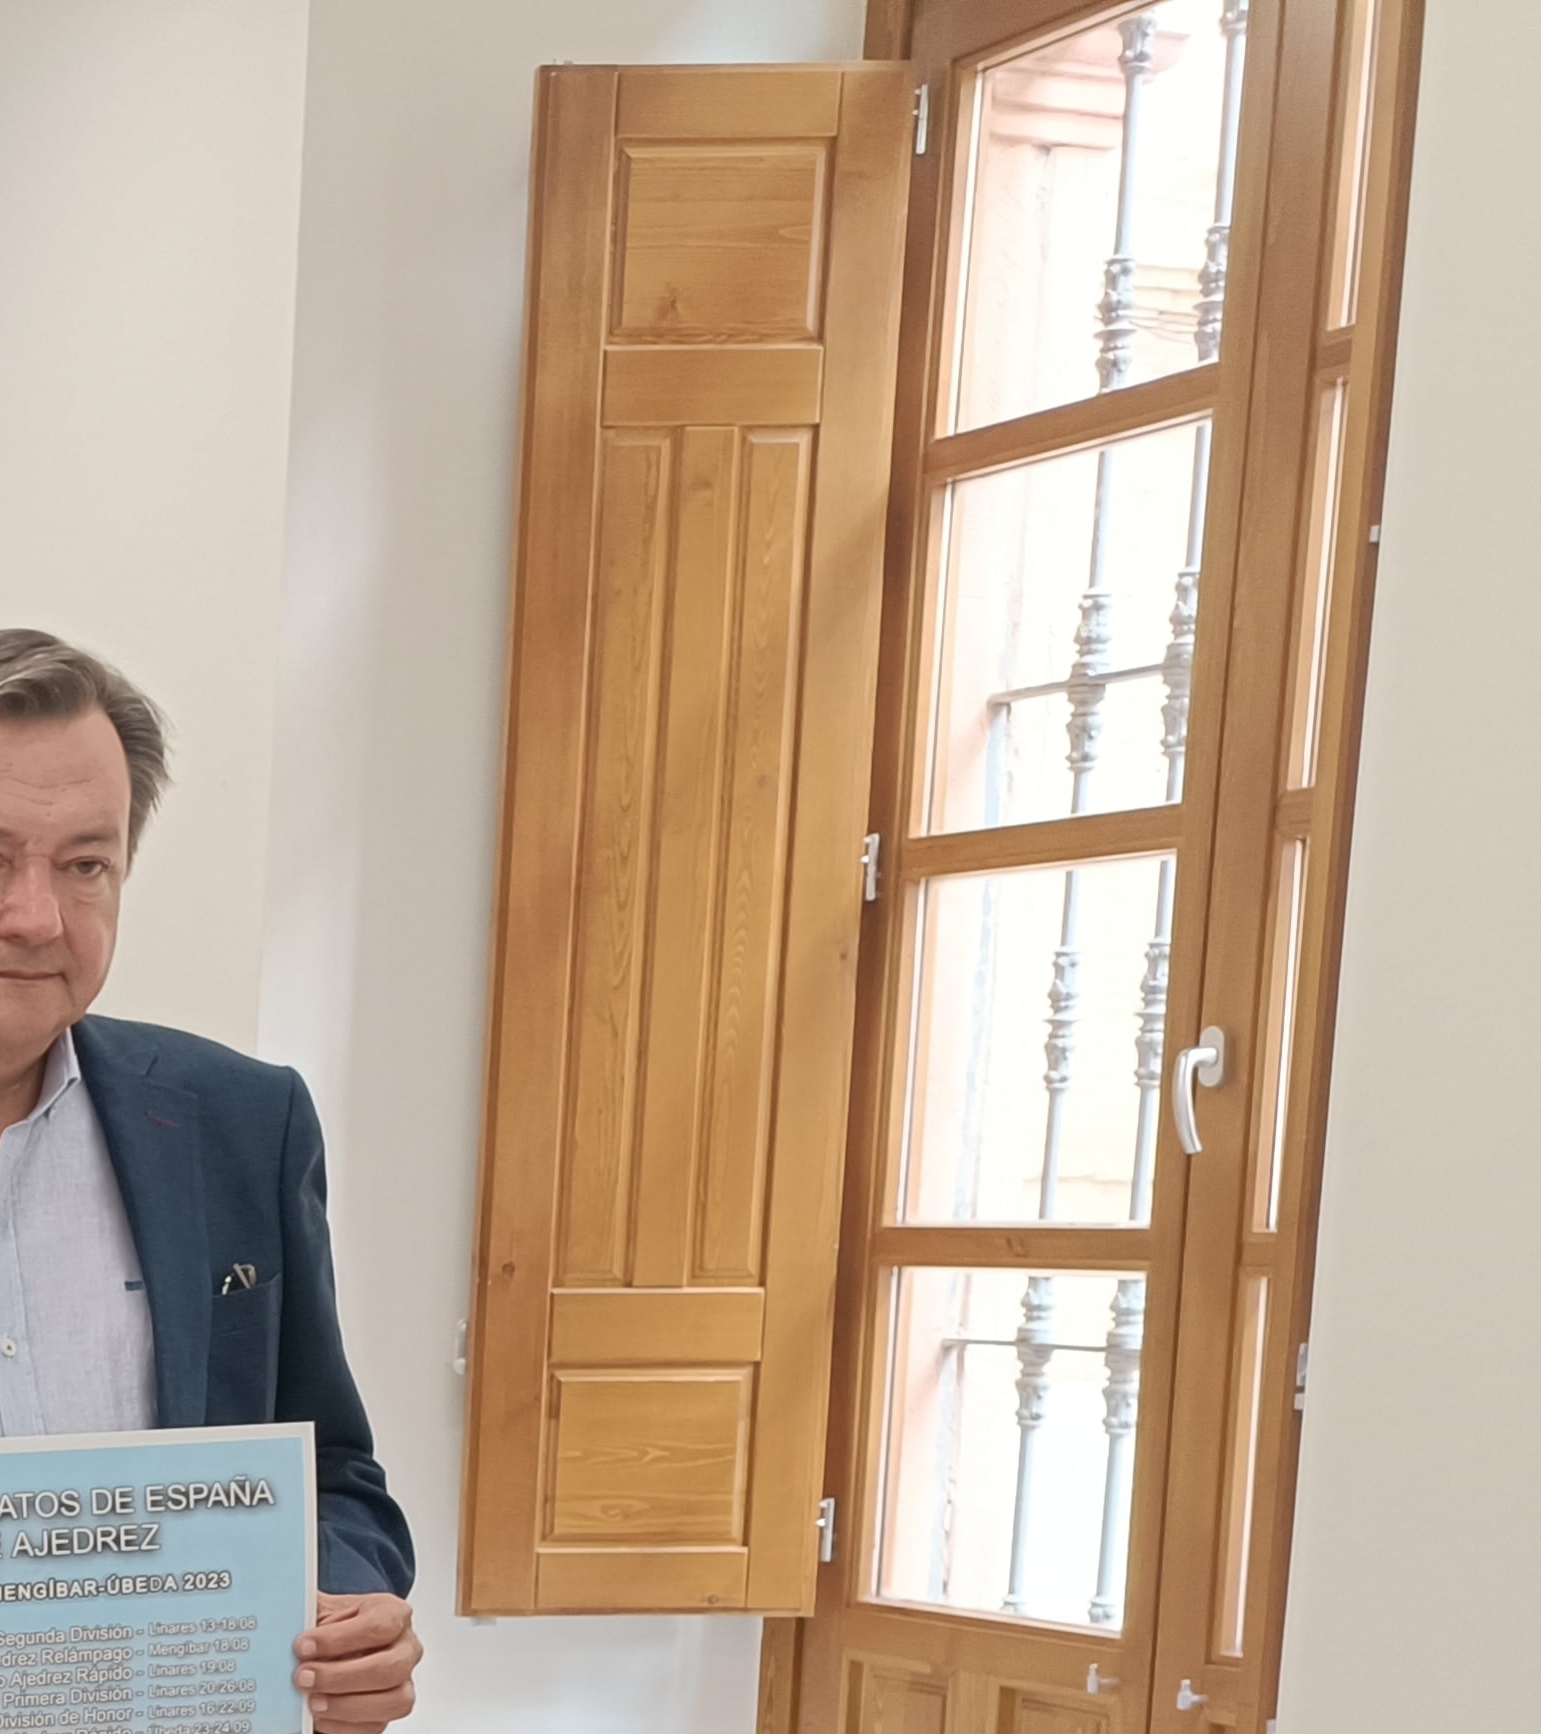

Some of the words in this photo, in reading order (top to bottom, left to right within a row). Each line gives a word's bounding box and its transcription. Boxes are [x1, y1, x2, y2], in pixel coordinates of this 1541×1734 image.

[94, 1488, 137, 1515] DE
[148, 1475, 276, 1512] ESPAÑA
[14, 1523, 161, 1558] AJEDREZ
[183, 1571, 231, 1592] 2023
[70, 1623, 132, 1642] División
[148, 1620, 196, 1636] Linares
[41, 1644, 132, 1667] Relámpago
[10, 1668, 71, 1690] Ajedrez
[75, 1665, 132, 1686] Rápido
[148, 1662, 196, 1677] Linares
[2, 1689, 65, 1708] Primera
[70, 1684, 132, 1704] División
[148, 1682, 196, 1698] Linares
[58, 1708, 79, 1725] de
[83, 1705, 132, 1723] Honor
[148, 1703, 196, 1719] Linares
